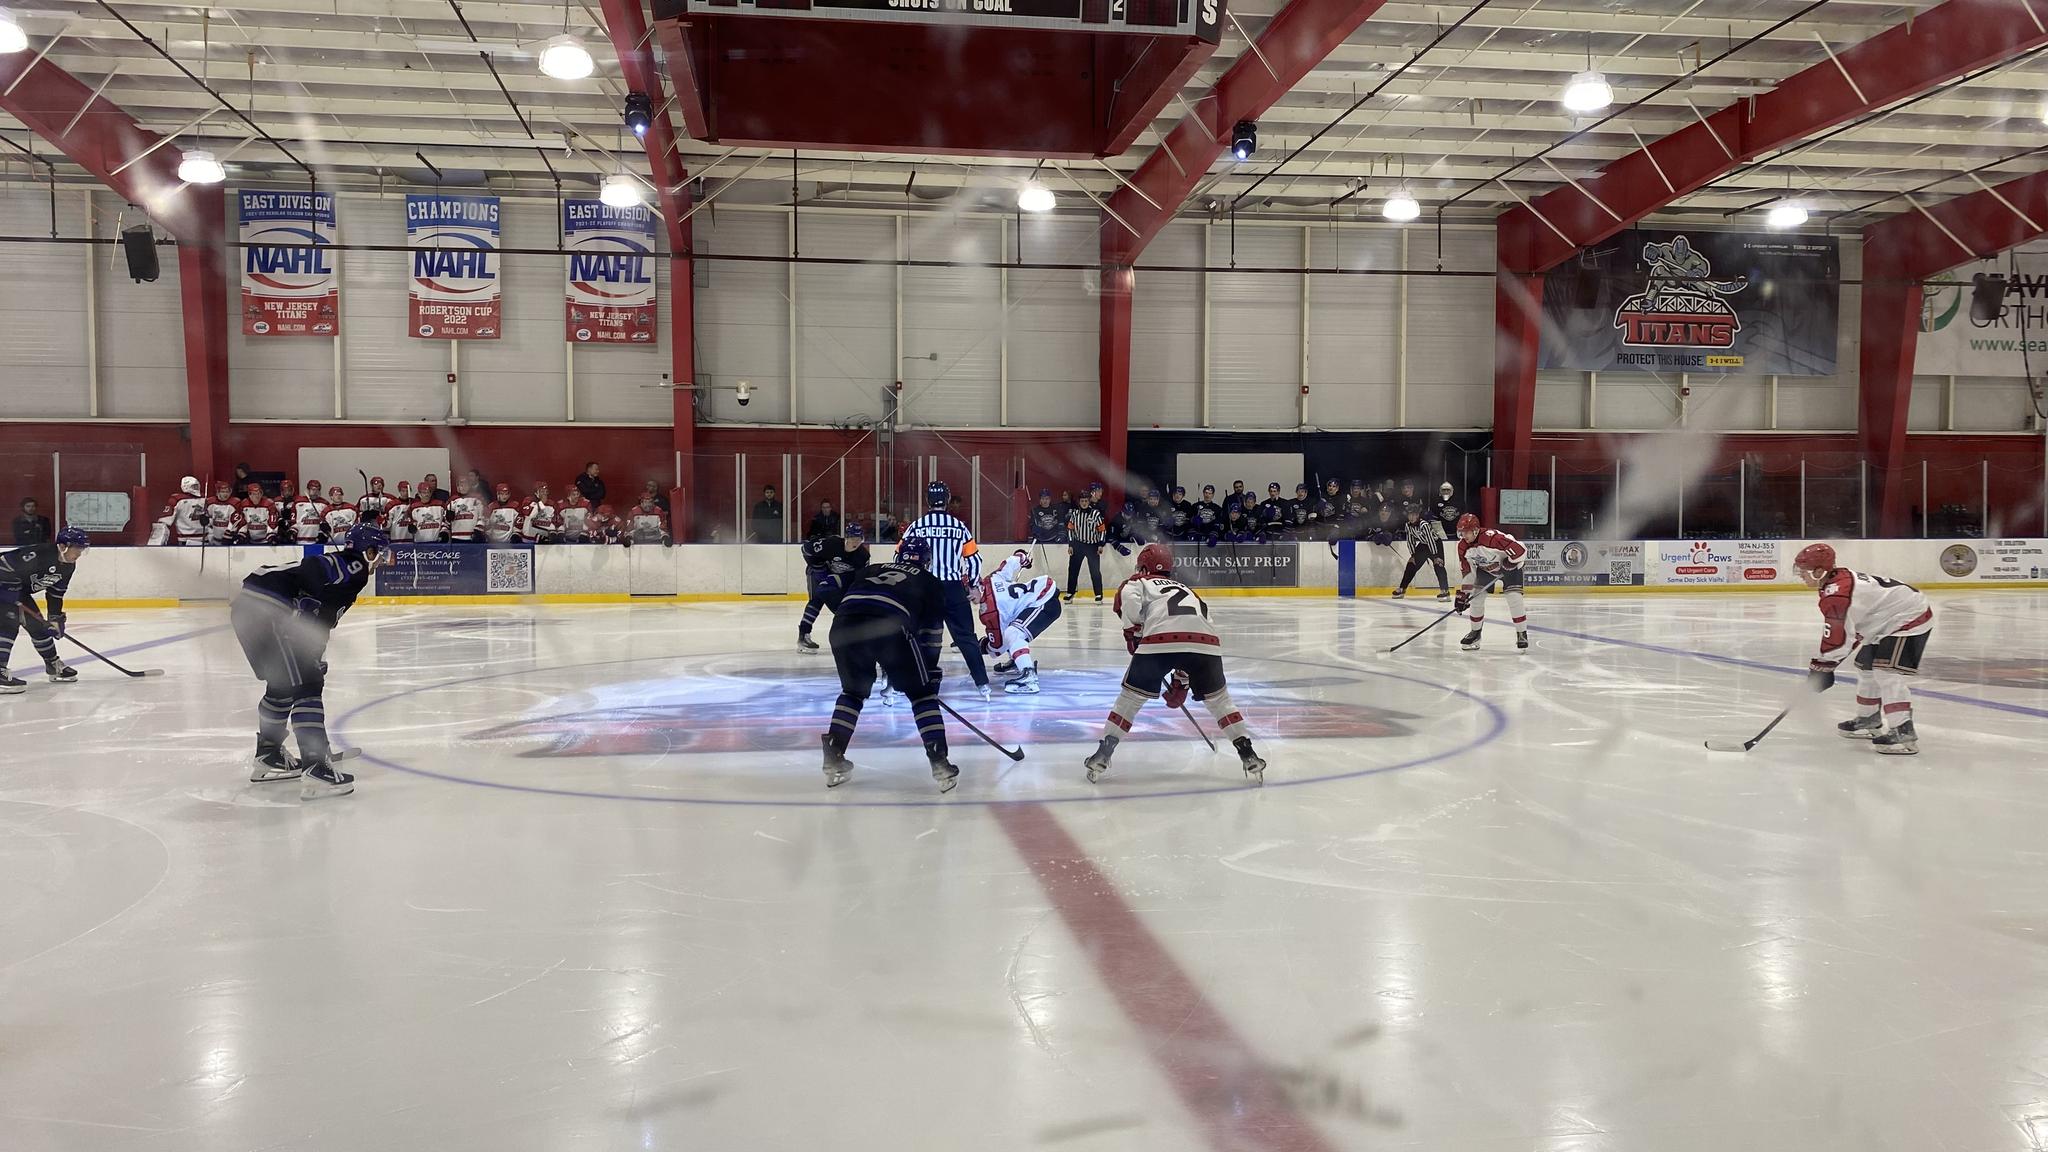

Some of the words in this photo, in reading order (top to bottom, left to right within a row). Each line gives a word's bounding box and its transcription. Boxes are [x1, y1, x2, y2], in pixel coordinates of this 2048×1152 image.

[243, 195, 275, 209] EAST
[279, 195, 331, 211] DIVISON
[407, 201, 498, 222] CHAMPIONS
[569, 205, 598, 219] EAST
[602, 205, 651, 221] DIVISION
[247, 246, 331, 274] NAHL
[414, 250, 495, 279] NAHL
[570, 255, 651, 283] NAHL
[264, 302, 283, 310] NEW
[286, 302, 318, 311] JERSEY
[419, 305, 472, 315] ROBERTSON
[475, 307, 492, 316] CUP
[276, 311, 307, 319] TITANS
[444, 315, 467, 324] 2022
[607, 312, 632, 320] JERSEY
[441, 327, 468, 335] NAHL.COM
[1618, 312, 1734, 345] TITANS
[597, 331, 626, 340] NAHL.COM
[1617, 354, 1656, 365] PROTECT
[1658, 354, 1673, 365] THIS
[1224, 556, 1250, 568] SAT
[1254, 556, 1291, 567] PREP
[1661, 553, 1691, 563] Urgent
[1708, 554, 1732, 562] Paws
[880, 563, 921, 576] MAGLIO
